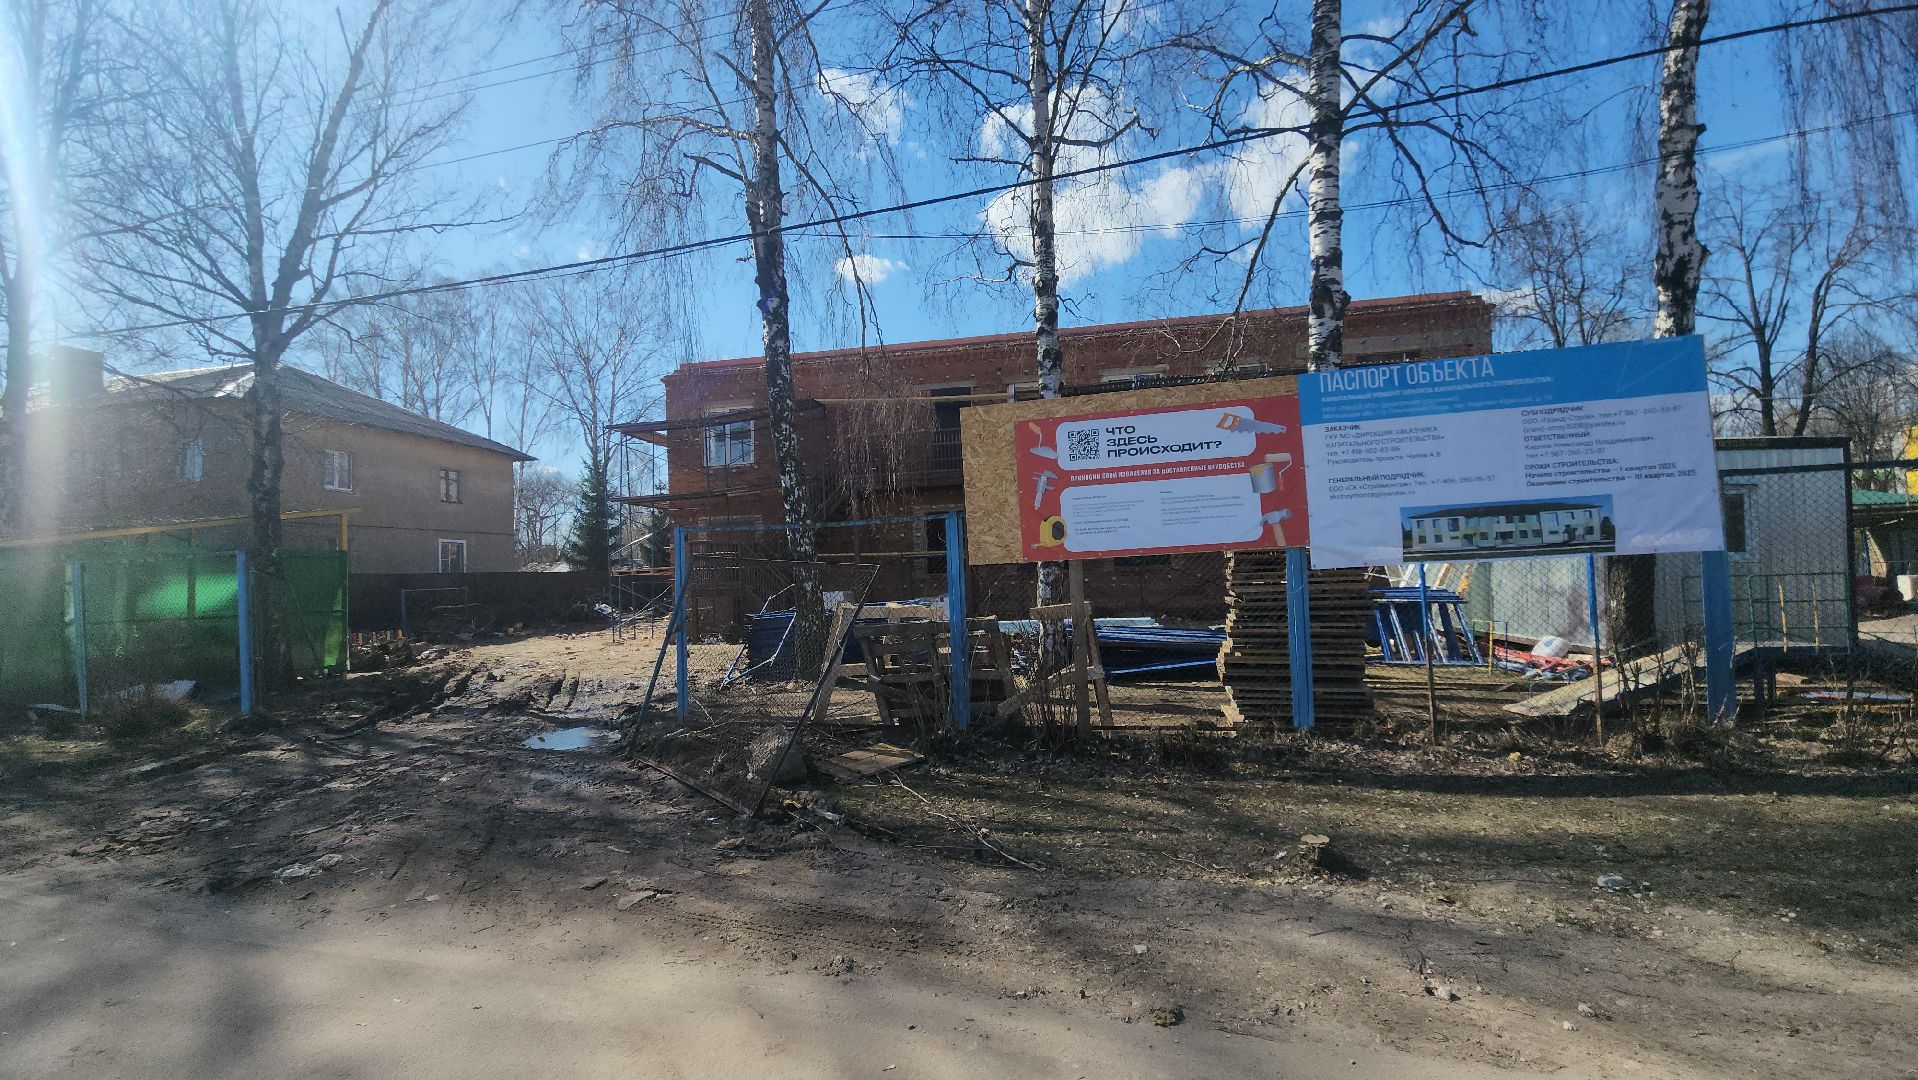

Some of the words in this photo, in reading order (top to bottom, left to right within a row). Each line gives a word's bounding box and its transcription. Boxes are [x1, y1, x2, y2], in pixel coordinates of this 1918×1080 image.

[1319, 365, 1401, 393] ПАСПОРТ
[1405, 356, 1495, 385] ОБЪЕКТА
[1105, 425, 1136, 436] ЧТО
[1106, 435, 1158, 447] ЗДЕСЬ
[1325, 439, 1380, 448] КАПИТАЛЬНОГО
[1107, 440, 1223, 458] ПРОИСХОДИТ?
[1554, 468, 1610, 477] строительства
[1624, 464, 1657, 472] квартал
[1658, 462, 1677, 470] 2025
[1328, 474, 1380, 484] ГЕНЕРАЛЬНЫЙ
[1567, 476, 1626, 484] строительства
